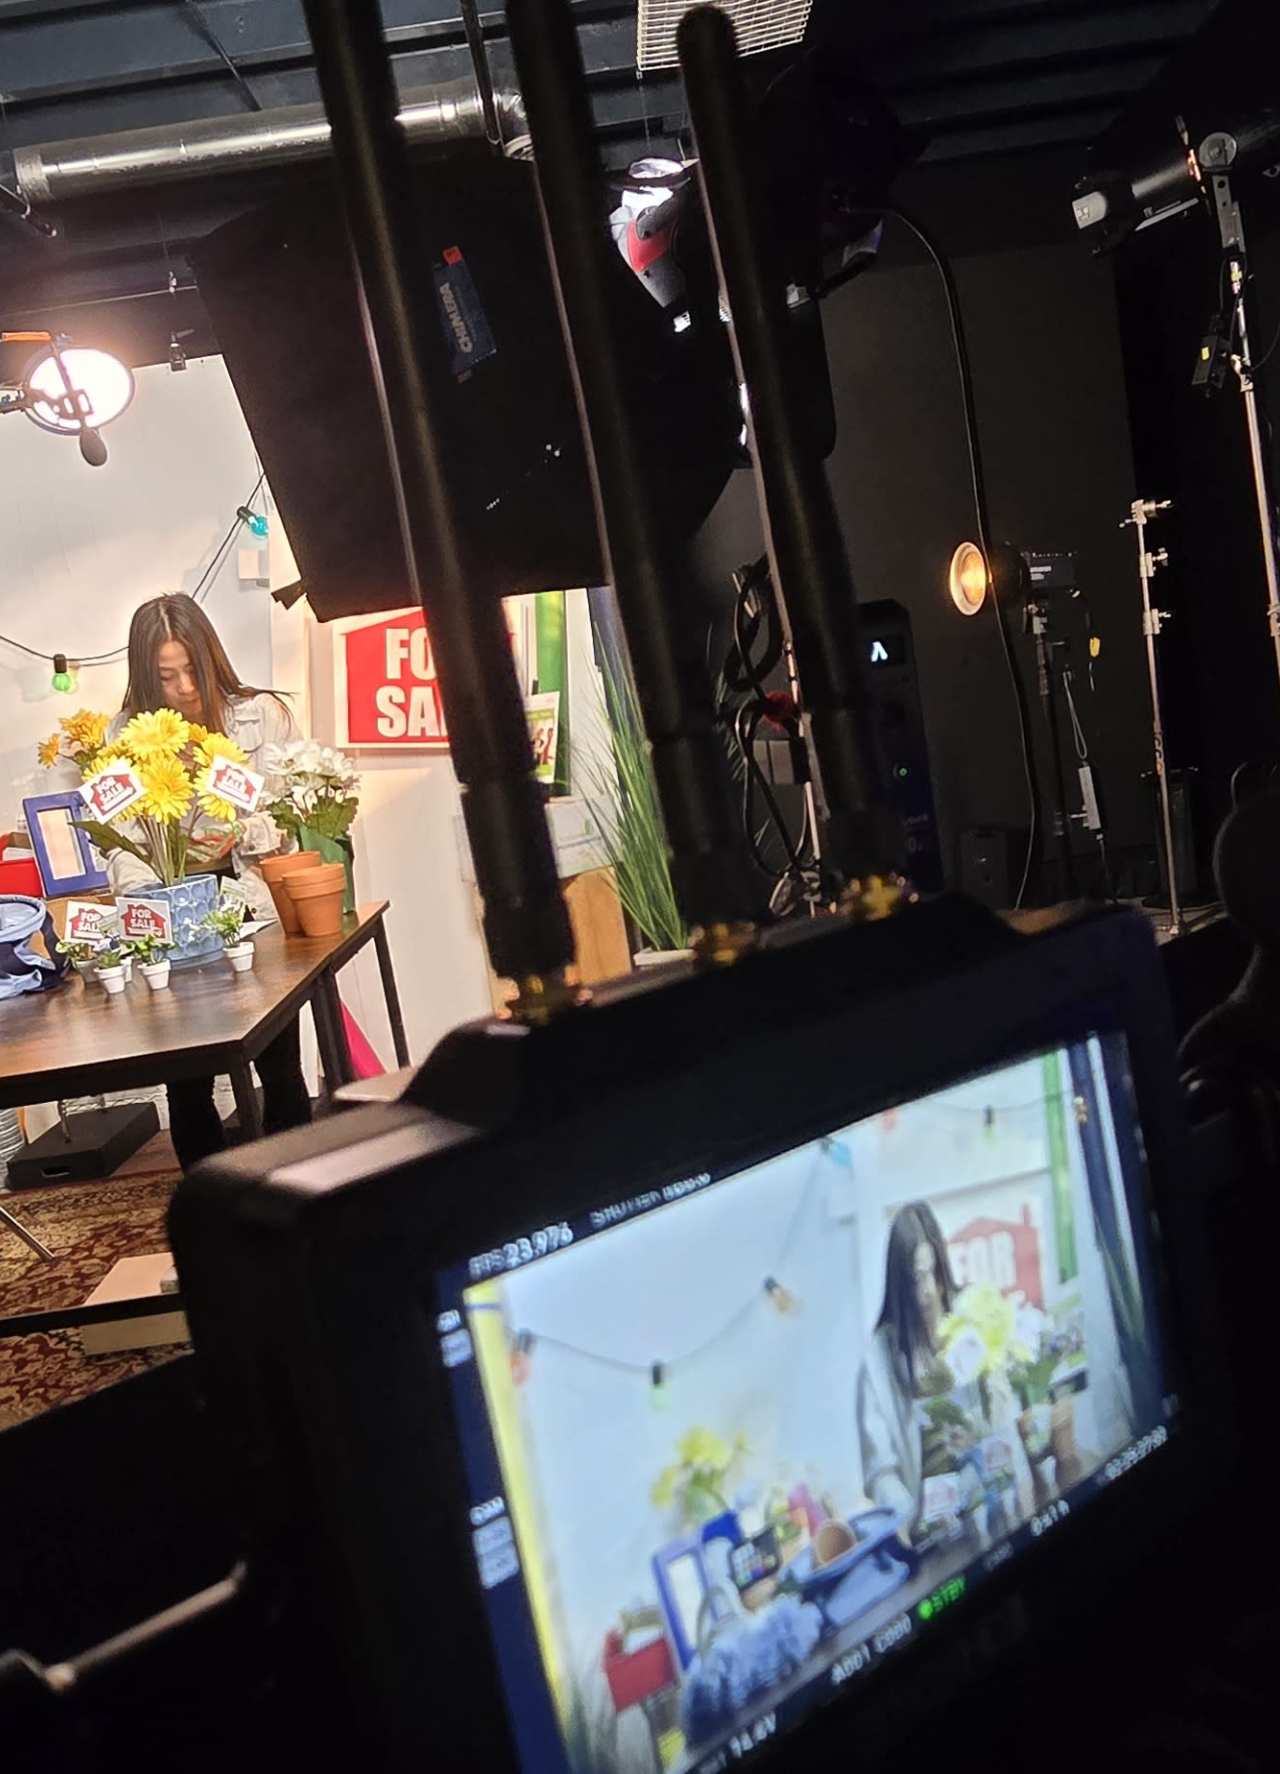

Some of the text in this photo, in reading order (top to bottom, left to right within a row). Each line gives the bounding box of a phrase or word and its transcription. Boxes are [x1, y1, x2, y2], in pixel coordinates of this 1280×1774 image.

[440, 282, 472, 353] CHIMERA
[386, 628, 437, 680] FO
[376, 685, 448, 738] SA
[77, 922, 101, 932] SAL
[130, 919, 155, 929] SALE
[131, 909, 152, 919] FOR
[503, 1220, 574, 1271] 23.976
[930, 1576, 967, 1615] STBY
